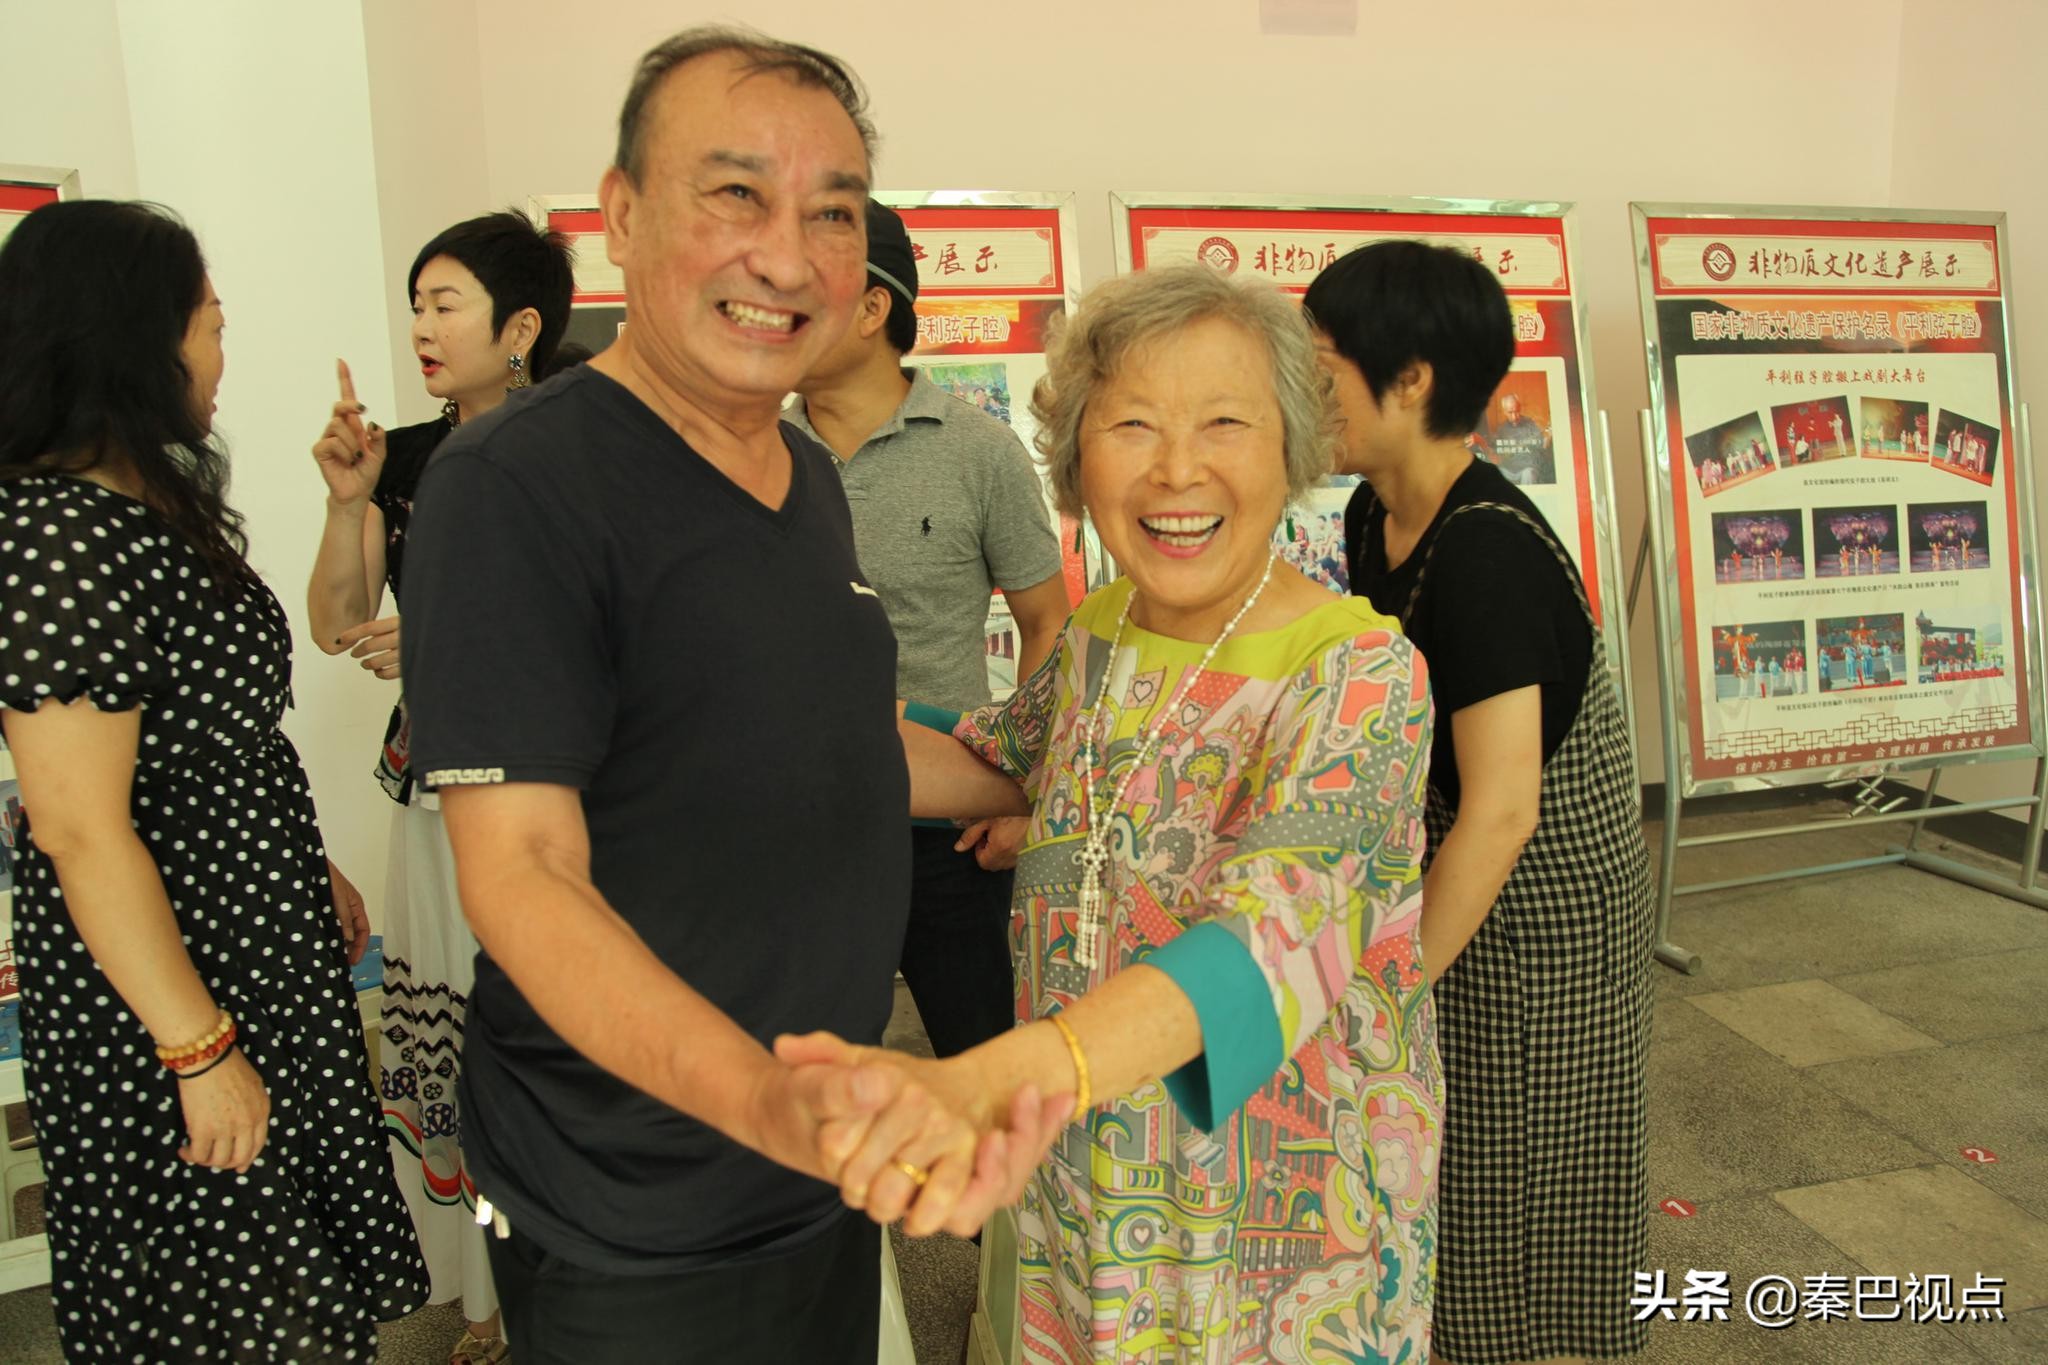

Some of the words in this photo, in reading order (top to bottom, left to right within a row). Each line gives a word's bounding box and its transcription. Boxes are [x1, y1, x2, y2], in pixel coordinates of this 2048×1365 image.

[1748, 248, 1961, 279] 非物质文化遗产展示
[1691, 310, 1982, 341] 国家非物质文化遗产保护名录《平利弦子腔》
[1735, 758, 1793, 774] 保护为主
[1875, 742, 1930, 759] 合理利用
[1942, 735, 1996, 751] 传承发展
[1965, 1148, 1995, 1163] 2
[1665, 1199, 1690, 1216] 1
